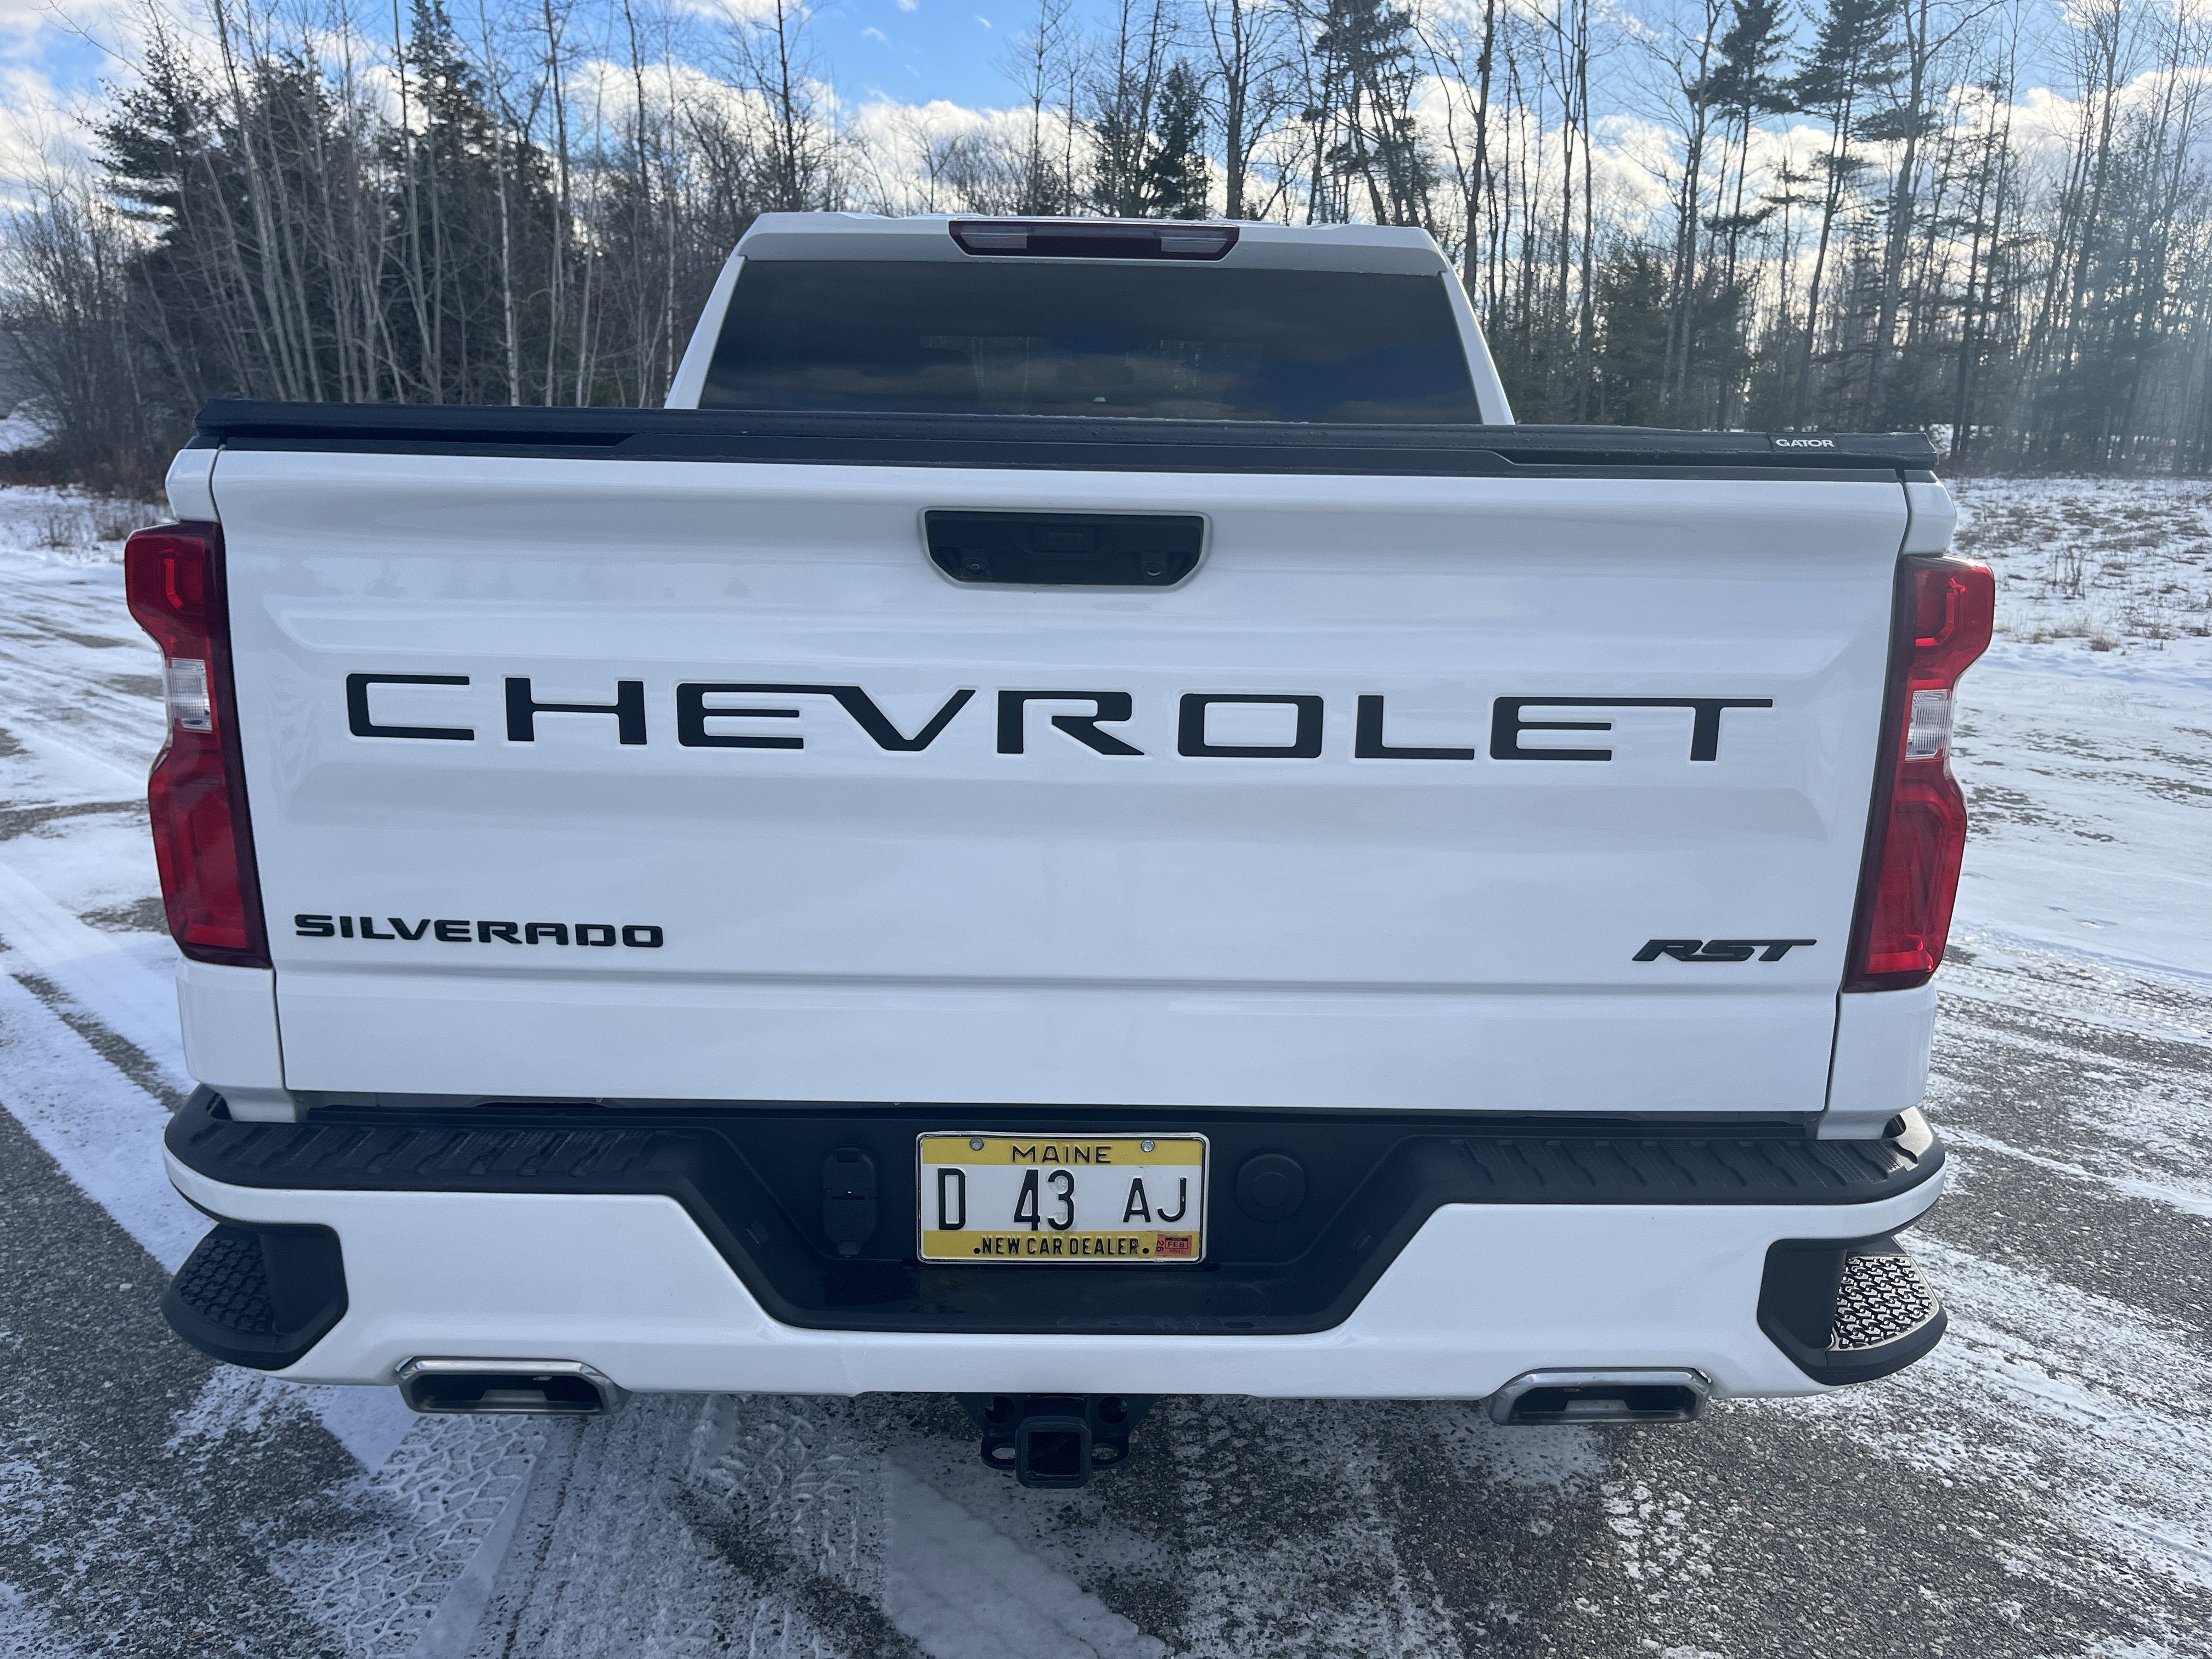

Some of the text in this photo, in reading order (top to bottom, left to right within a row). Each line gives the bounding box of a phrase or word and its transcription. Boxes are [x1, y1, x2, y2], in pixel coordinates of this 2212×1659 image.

[1775, 439, 1835, 447] GATOR
[345, 673, 1773, 761] CHEVROLET
[294, 914, 664, 948] SILVERADO
[1632, 939, 1818, 962] RST
[1012, 1145, 1112, 1164] MAINE
[938, 1167, 1187, 1232] D 43 AJ
[982, 1237, 1139, 1255] NEW CAR DEALER
[1156, 1240, 1164, 1252] 26
